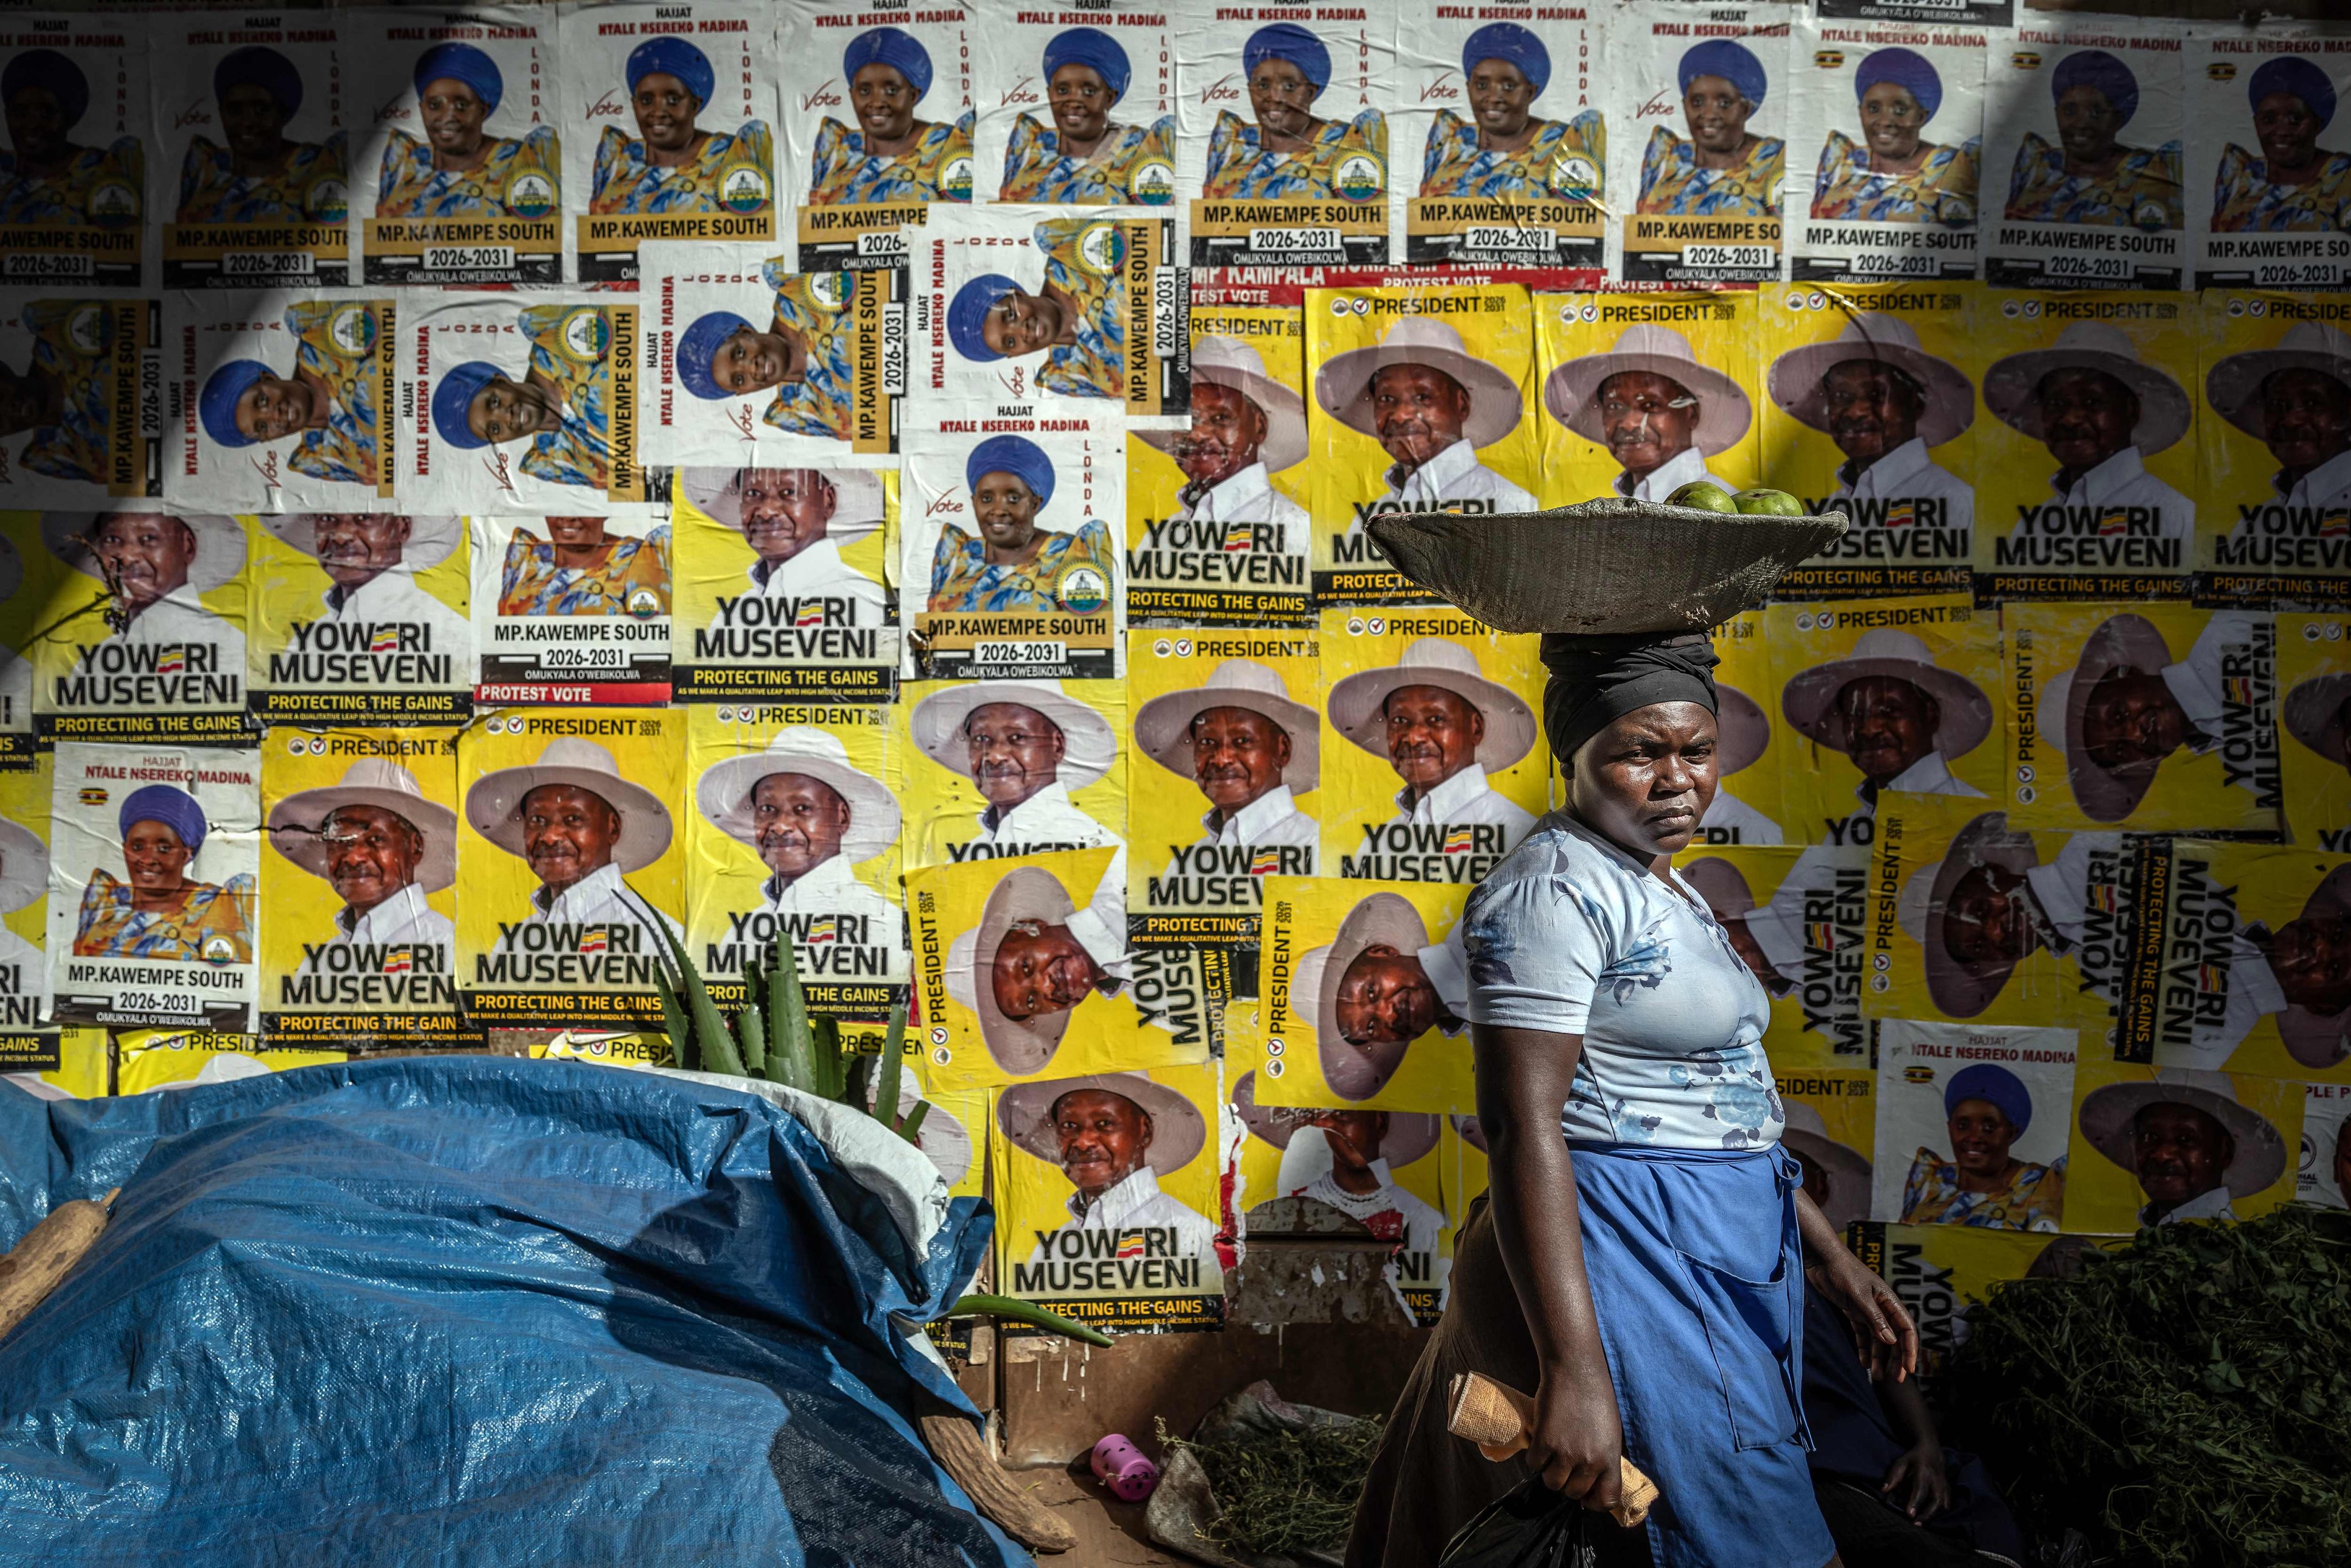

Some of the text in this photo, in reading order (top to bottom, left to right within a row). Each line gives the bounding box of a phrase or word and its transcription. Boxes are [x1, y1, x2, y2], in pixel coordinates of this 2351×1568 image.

[816, 10, 965, 28] NTALE NSEREKO MADINA
[1217, 8, 1365, 20] NTALE NSEREKO MADINA
[1437, 7, 1586, 20] NTALE NSEREKO MADINA
[1202, 73, 1239, 103] Vote
[1204, 206, 1380, 222] MP.KAWEMPE SOUTH
[1422, 205, 1597, 224] MP.KAWEMPE SOUTH
[377, 223, 554, 241] MP.KAWEMPE SOUTH
[591, 218, 767, 237] MP.KAWEMPE SOUTH
[1638, 222, 1753, 239] MP.KAWEMPE
[1256, 231, 1334, 247] 2026-2031
[1807, 228, 1923, 249] MP.KAWEMPE
[2001, 230, 2175, 255] MP.KAWEMPE SOUTH
[430, 250, 508, 266] 2026-2031
[1690, 248, 1768, 265] 2026-2031
[2209, 240, 2324, 258] MP.KAWEMPE
[1858, 255, 1935, 273] 2026-2031
[2052, 257, 2129, 275] 2026-2031
[2261, 265, 2338, 283] 2026-2031
[1231, 290, 1269, 302] VOTE
[1829, 293, 1933, 311] PRESIDENT
[1131, 227, 1148, 402] MP.KAWEMPE SOUTH
[1158, 271, 1173, 351] 2026-2031
[1375, 296, 1479, 315] PRESIDENT
[1604, 305, 1709, 321] PRESIDENT
[2046, 301, 2152, 319] PRESIDENT
[661, 276, 674, 425] NTALE NSEREKO MADINA
[885, 308, 903, 388] 2026-2031
[859, 324, 876, 440] MP.KAWEMPE
[143, 354, 160, 432] 2026-2031
[617, 312, 631, 487] MP.KAWEMPE SOUTH
[998, 406, 1033, 416] HAJJAT
[940, 420, 1089, 433] NTALE NSEREKO MADINA
[926, 487, 963, 517] Vote
[1146, 518, 1284, 552] YOWERI
[1997, 538, 2179, 566] MUSEVENI
[1886, 572, 1970, 584] THE GAINS
[1995, 577, 2181, 594] PROTECTING THE GAINS
[1221, 595, 1305, 611] THE GAINS
[717, 598, 855, 627] YOWERI
[1840, 608, 1946, 628] PRESIDENT
[496, 624, 668, 641] MP.KAWEMPE SOUTH
[929, 619, 1105, 636] MP.KAWEMPE SOUTH
[292, 622, 429, 652] YOWERI
[695, 629, 876, 658] MUSEVENI
[79, 643, 216, 673] YOWERI
[547, 649, 624, 666] 2026-2031
[981, 644, 1060, 661] 2026-2031
[1197, 642, 1302, 657] PRESIDENT
[270, 654, 449, 682] MUSEVENI
[525, 670, 575, 680] OMUKYALA
[957, 665, 1007, 678] OMUKYALA
[693, 670, 878, 685] PROTECTING THE GAINS
[57, 676, 238, 705] MUSEVENI
[481, 687, 591, 701] PROTEST VOTE
[269, 695, 453, 710] PROTECTING THE GAINS
[2019, 654, 2033, 761] PRESIDENT
[55, 716, 240, 732] PROTECTING THE GAINS
[760, 708, 863, 724] PRESIDENT
[529, 719, 637, 735] PRESIDENT
[331, 740, 437, 755] PRESIDENT
[1363, 824, 1504, 853] YOWERI
[1169, 846, 1311, 874] YOWERI
[1876, 843, 1900, 950] PRESIDENT
[1149, 918, 1247, 932] PROTECTING
[499, 923, 639, 953] YOWERI
[304, 944, 443, 973] YOWERI
[1803, 890, 1833, 1032] YOWERI
[2163, 859, 2209, 1045] MUSEVENI
[918, 915, 944, 1024] PRESIDENT
[1834, 870, 1865, 1055] MUSEVENI
[69, 966, 243, 988] MP.KAWEMPE SOUTH
[1270, 926, 1289, 1033] PRESIDENT
[120, 993, 197, 1011] 2026-2031
[475, 995, 661, 1010] PROTECTING THE GAINS
[808, 987, 890, 1002] THE GAINS
[281, 1016, 414, 1030] PROTECTING THE
[1034, 1228, 1176, 1259] YOWERI
[1016, 1258, 1198, 1291] MUSEVENI
[1121, 1300, 1202, 1315] THE GAINS
